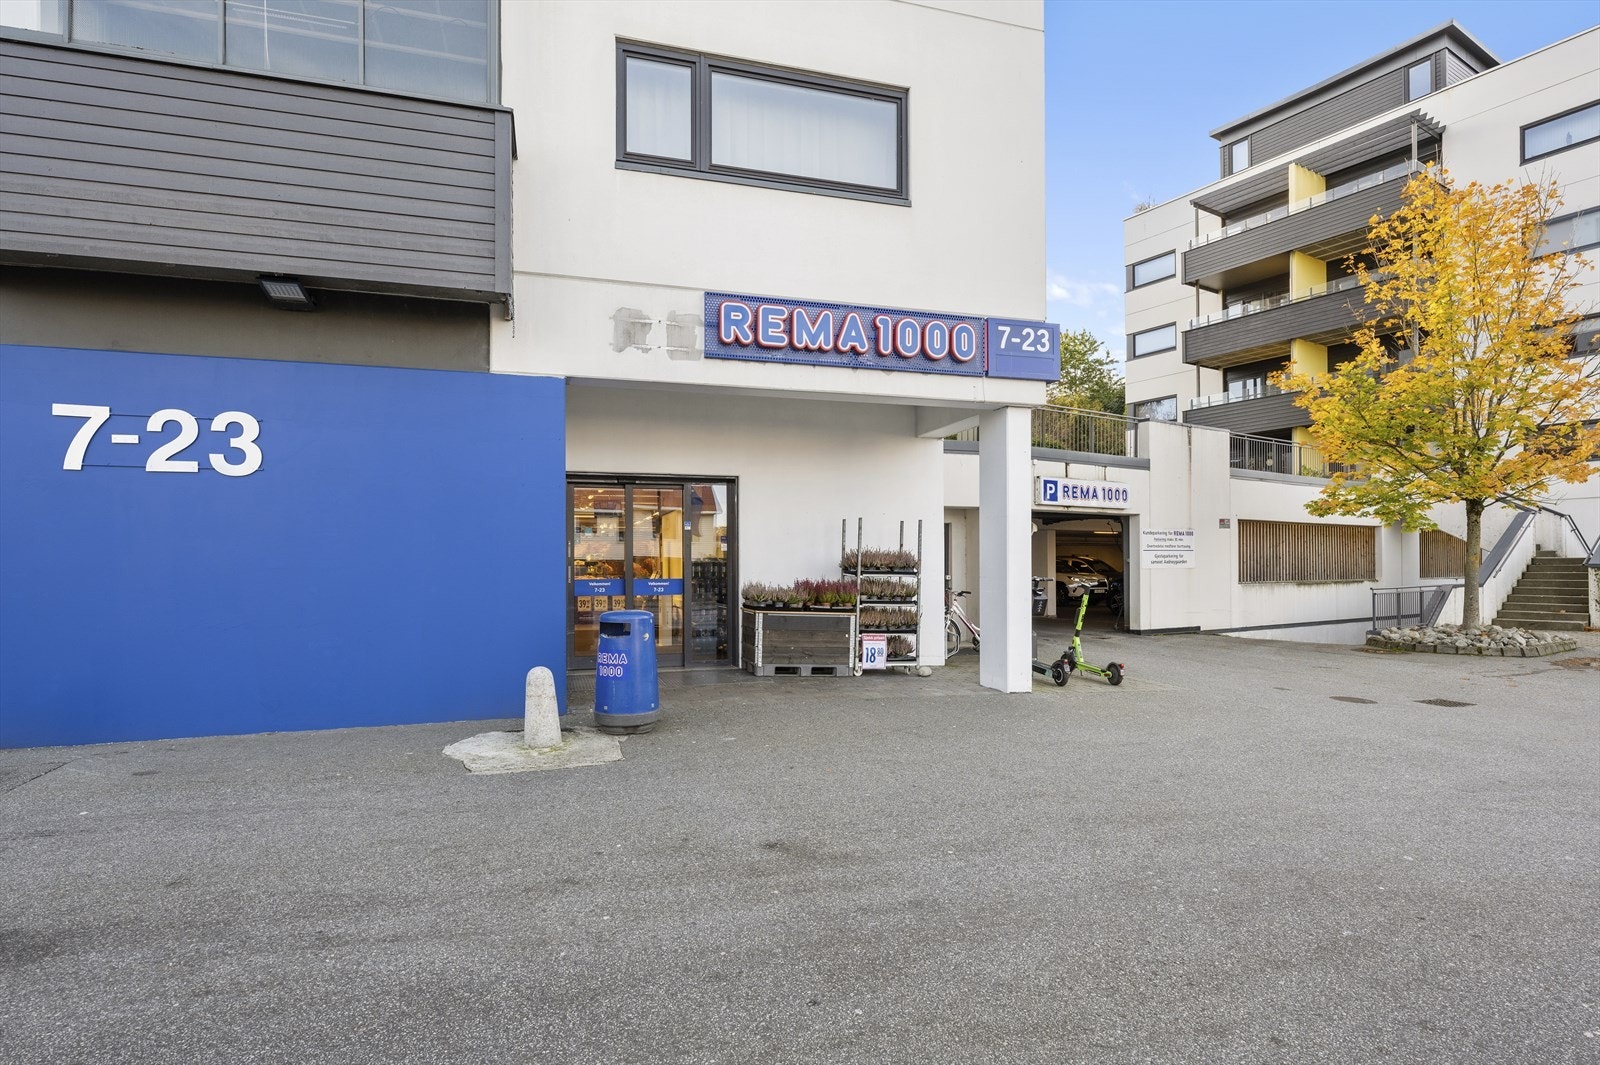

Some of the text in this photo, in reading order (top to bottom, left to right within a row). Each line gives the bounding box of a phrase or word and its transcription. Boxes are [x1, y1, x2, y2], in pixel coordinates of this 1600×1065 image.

[719, 301, 977, 362] REMA 1000
[998, 326, 1050, 353] 7-23
[52, 403, 263, 477] 7-23
[1046, 483, 1128, 503] P REMA 1000
[865, 647, 876, 663] 18
